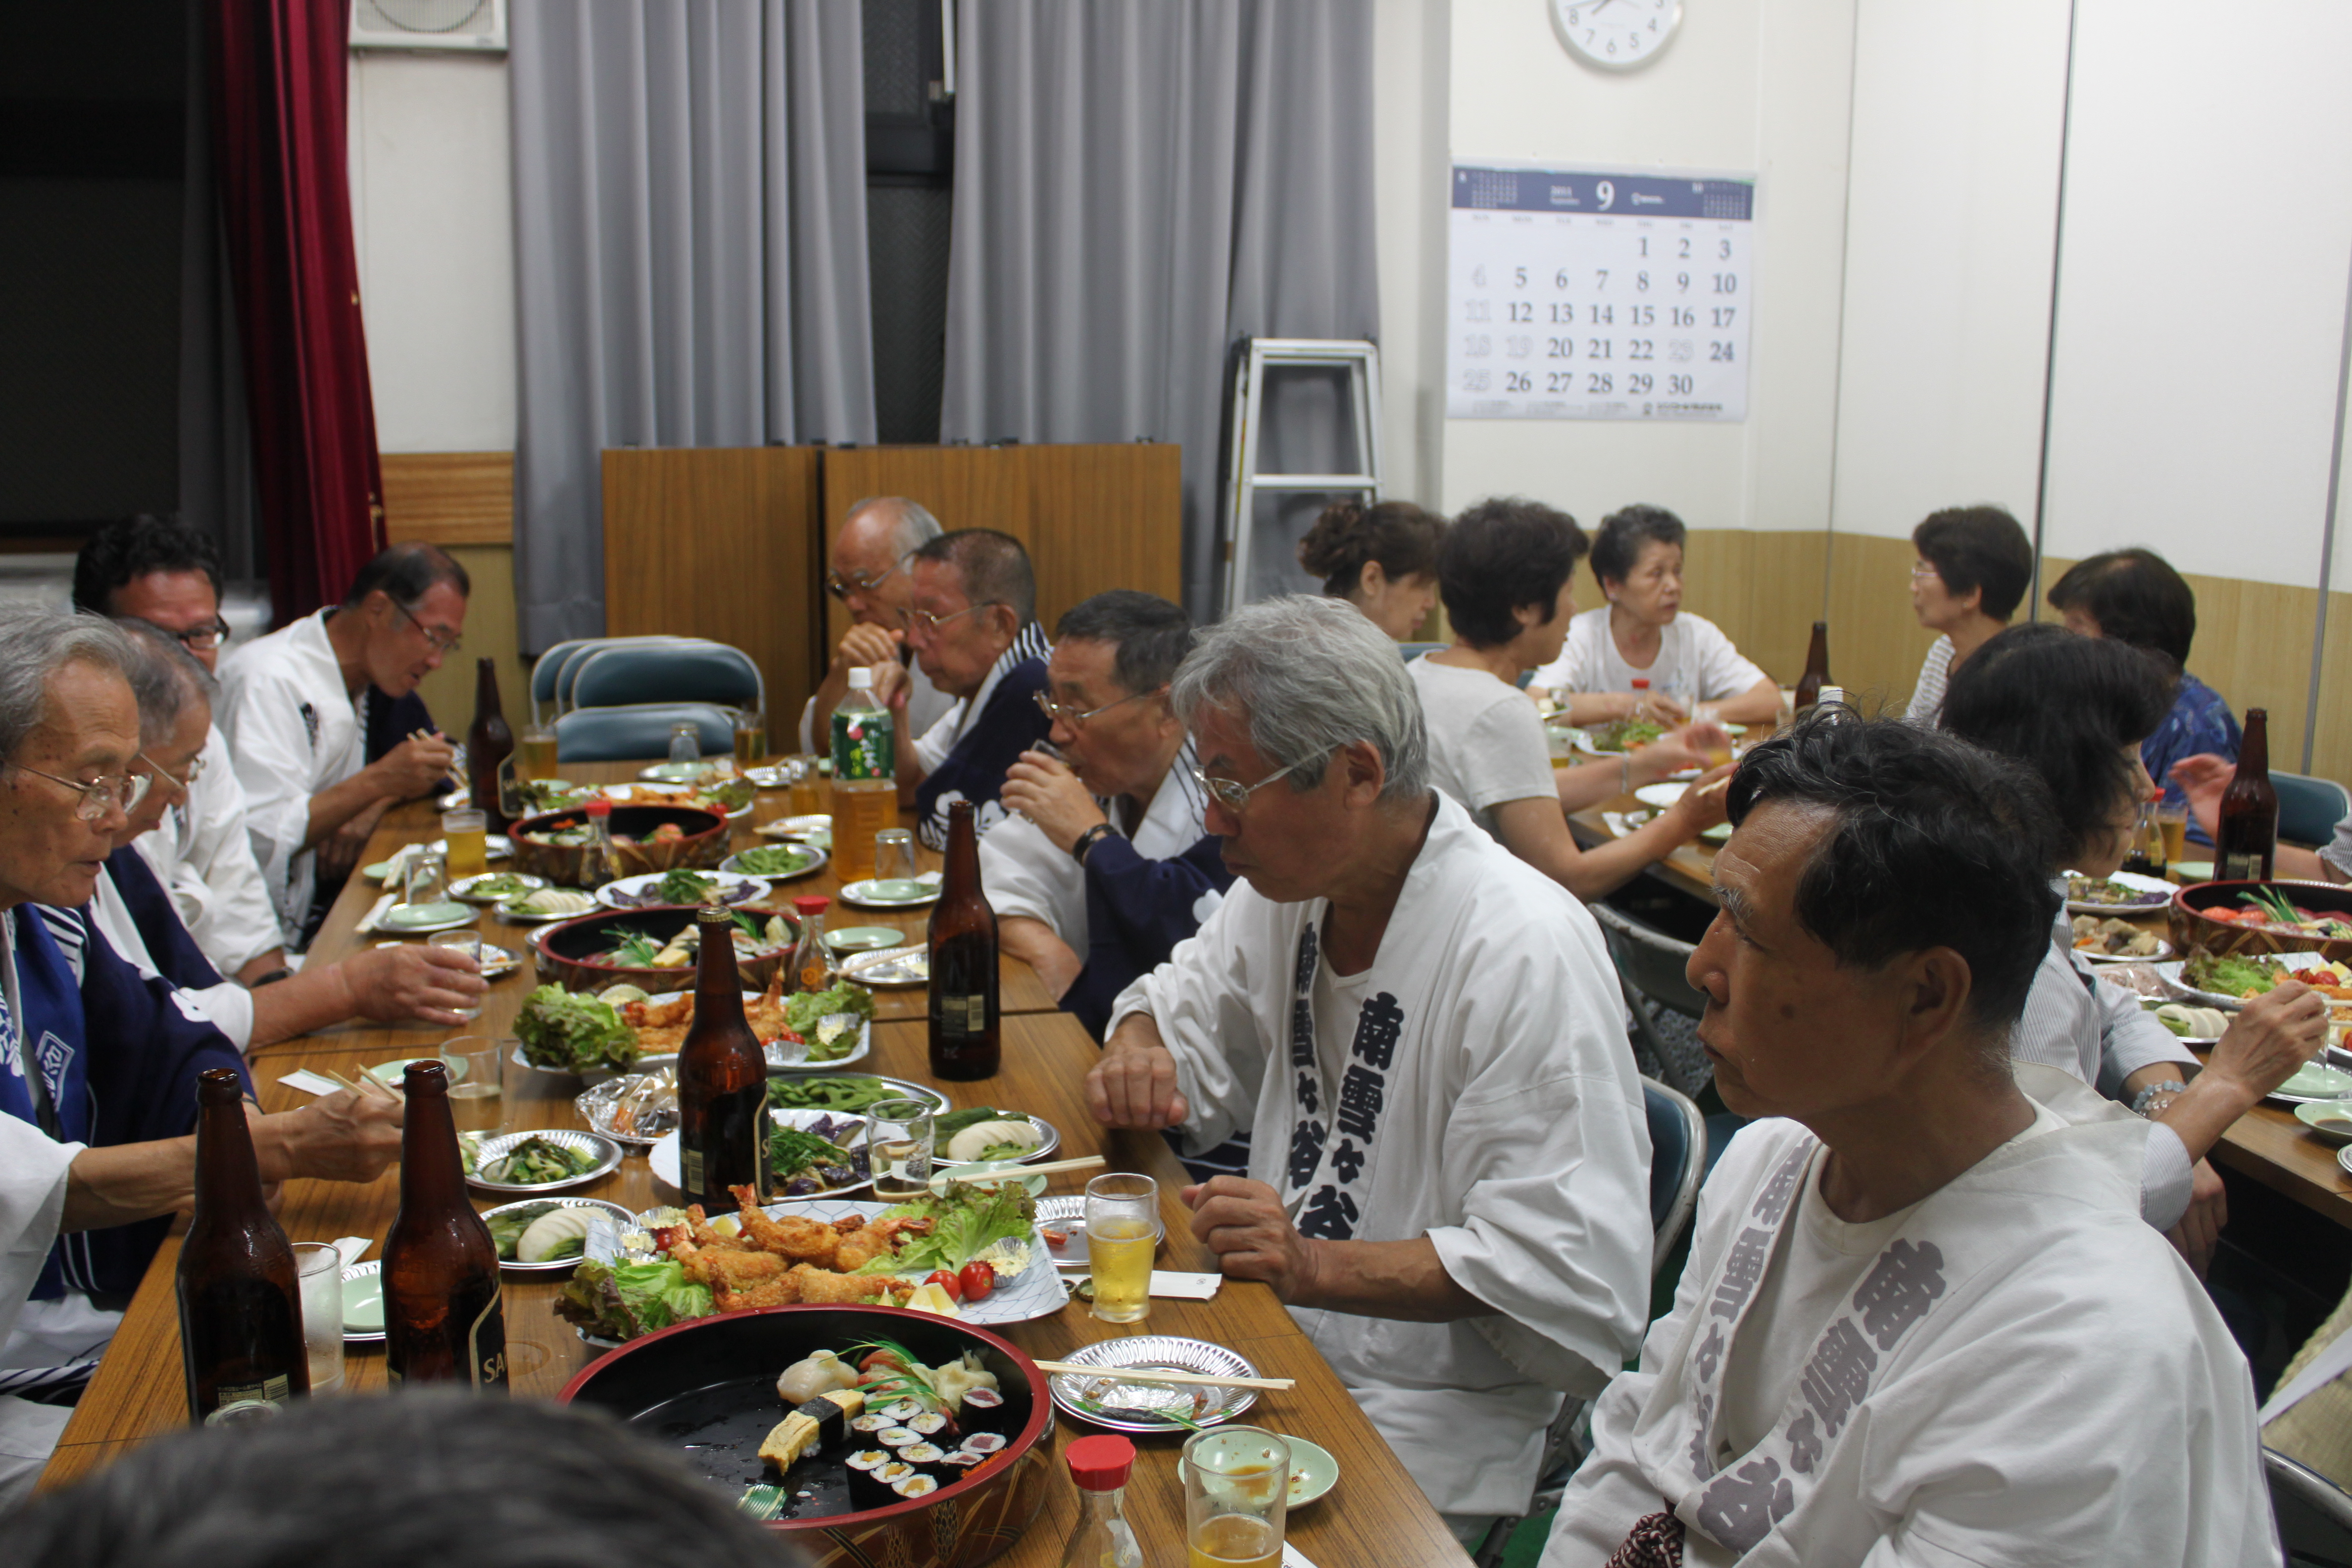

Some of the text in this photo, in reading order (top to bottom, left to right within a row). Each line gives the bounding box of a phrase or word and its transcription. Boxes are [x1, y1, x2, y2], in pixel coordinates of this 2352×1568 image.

[1569, 8, 1579, 25] 8
[1648, 17, 1657, 32] 4
[1587, 28, 1595, 46] 7
[1607, 38, 1617, 53] 6
[1630, 32, 1639, 49] 5
[1597, 181, 1614, 210] 9
[1639, 237, 1731, 260] 1 2 3
[1515, 267, 1527, 287] 5
[1555, 269, 1568, 290] 6
[1596, 269, 1609, 290] 7
[1636, 271, 1650, 292] 8
[1677, 272, 1689, 294] 9
[1715, 274, 1736, 294] 10
[1510, 302, 1532, 323] 12
[1551, 303, 1573, 323] 13
[1592, 305, 1613, 324] 14
[1632, 306, 1655, 325] 15
[1673, 307, 1695, 327] 16
[1713, 308, 1735, 327] 17
[1548, 338, 1573, 358] 20
[1589, 339, 1611, 359] 21
[1630, 340, 1653, 360] 22
[1711, 342, 1733, 361] 24
[1507, 372, 1531, 392] 26
[1547, 372, 1572, 393] 27
[1588, 374, 1613, 393] 28
[1629, 374, 1653, 394] 29
[1668, 375, 1693, 394] 30
[482, 1352, 507, 1383] SA
